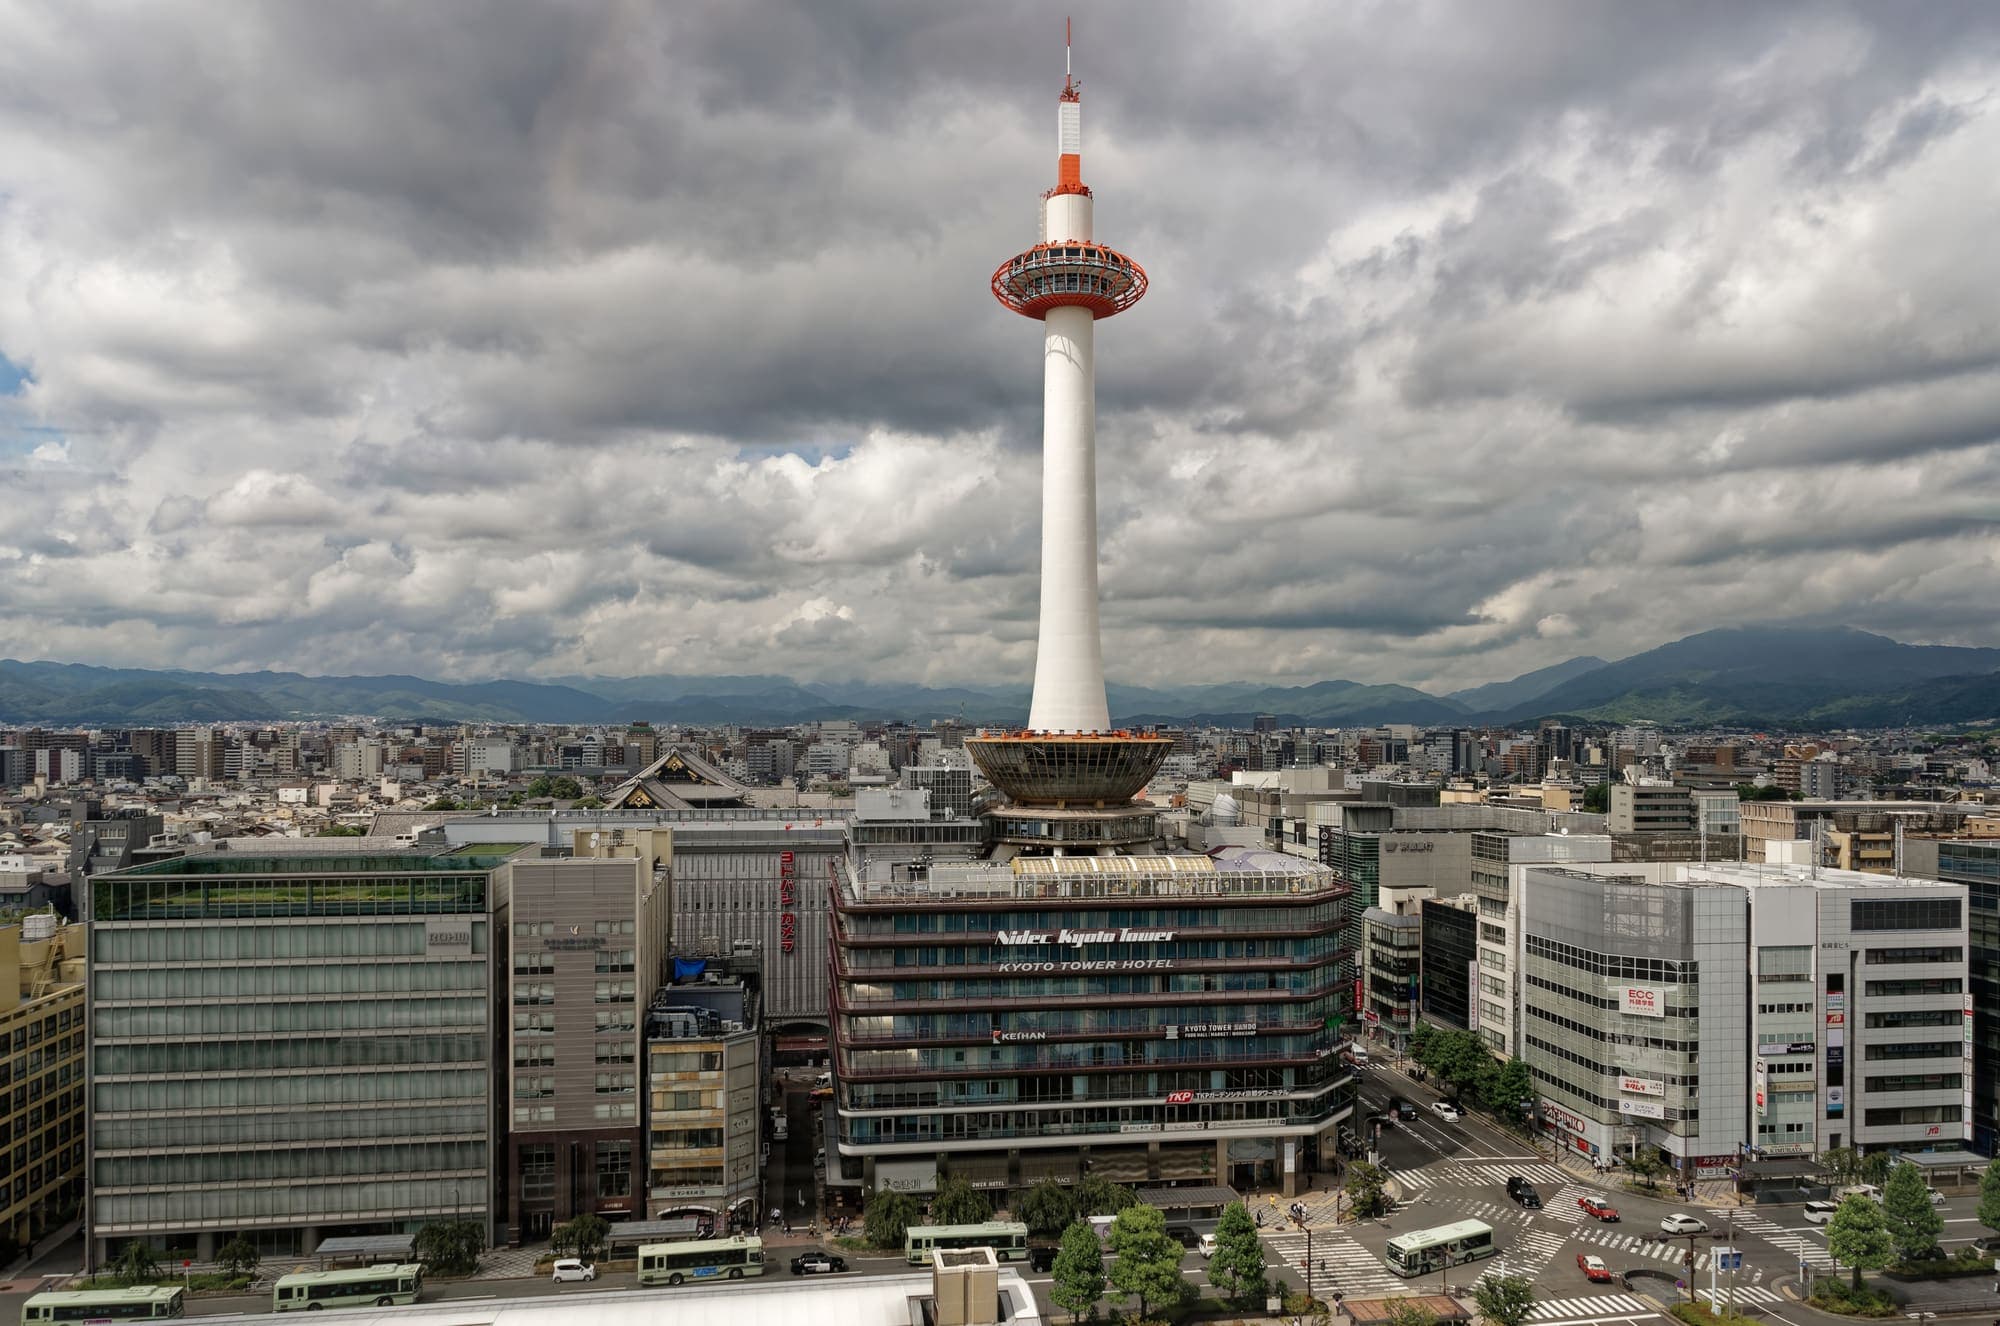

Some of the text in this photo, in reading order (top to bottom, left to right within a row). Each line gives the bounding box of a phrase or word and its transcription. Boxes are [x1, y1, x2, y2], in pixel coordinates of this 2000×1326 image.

[781, 851, 795, 952] ヨドバシ カメラ
[995, 928, 1178, 948] Nidec Kyoto Tower
[999, 959, 1174, 972] KYOTO TOWER HOTEL
[1629, 990, 1654, 1000] ECC
[1002, 1031, 1046, 1041] KEIHAN
[1167, 1092, 1191, 1102] TKP
